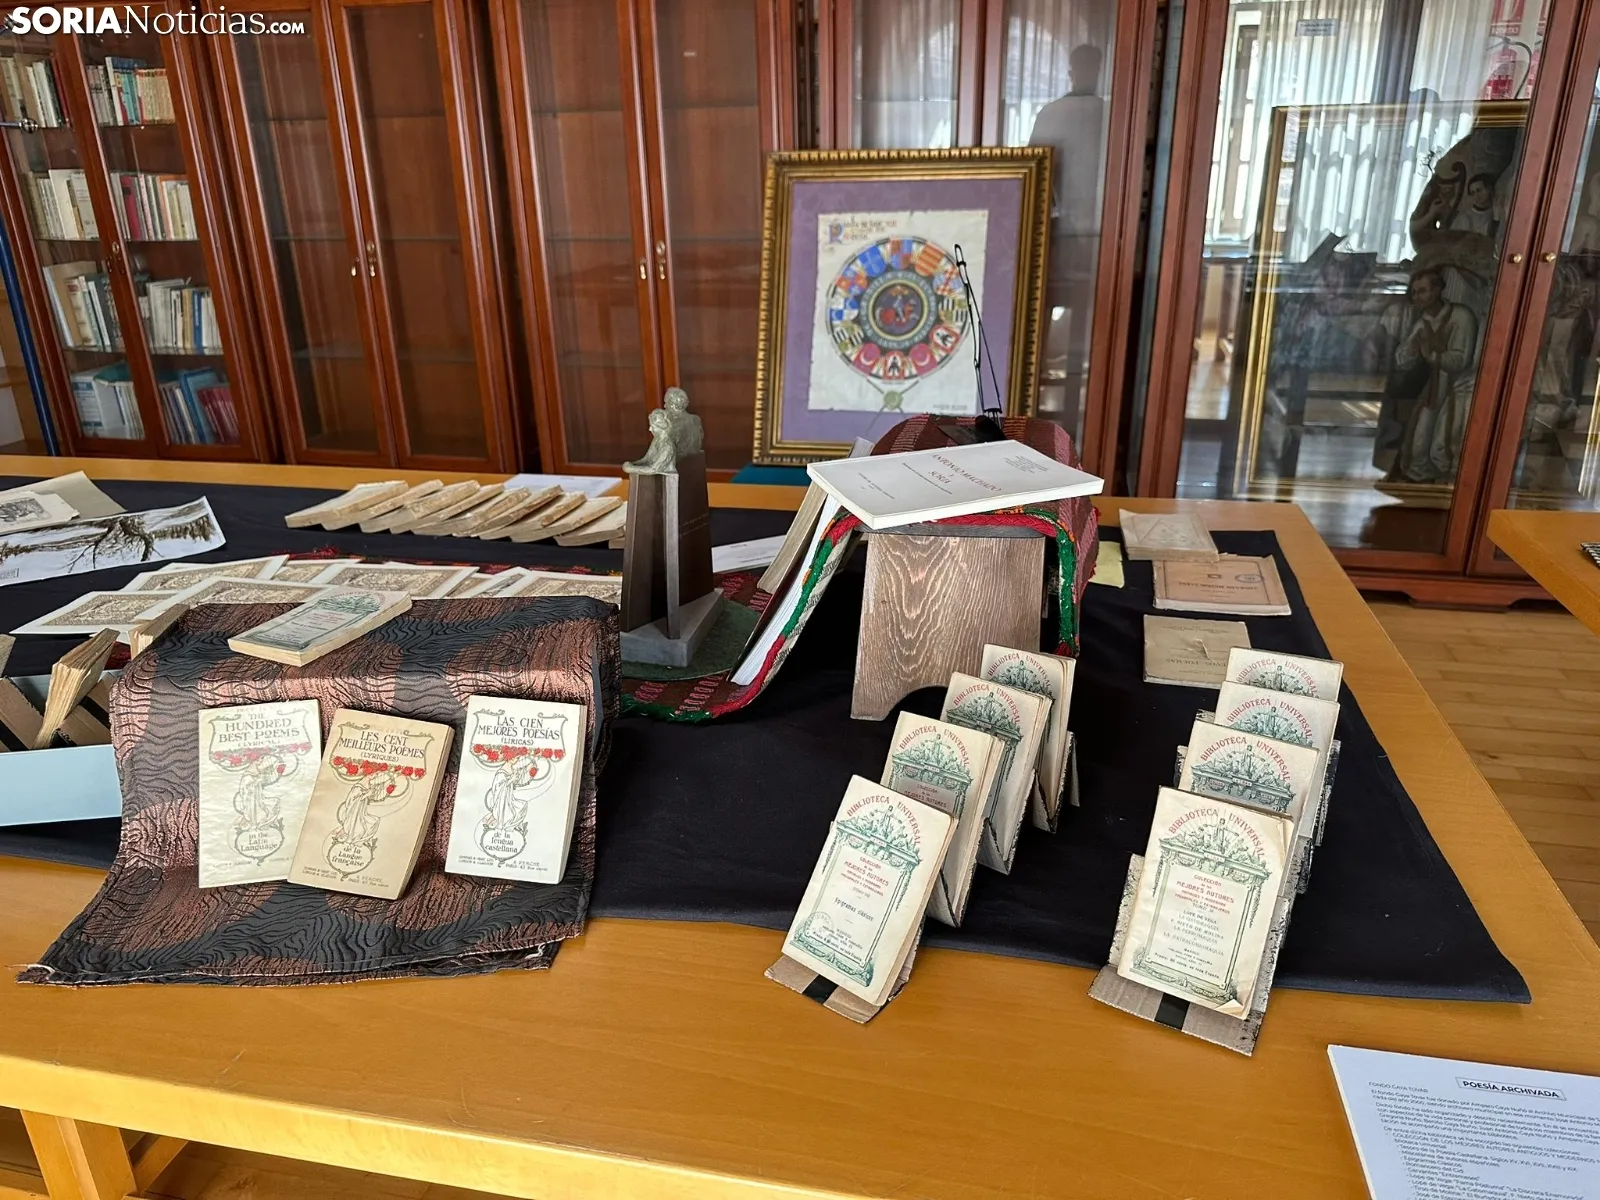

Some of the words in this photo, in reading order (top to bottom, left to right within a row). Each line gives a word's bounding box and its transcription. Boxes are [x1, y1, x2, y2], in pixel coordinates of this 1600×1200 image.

[987, 652, 1020, 676] BIBLIOTECA
[1025, 655, 1051, 688] UNIVERSAL
[1237, 658, 1276, 683] BIBLIOTECA
[1284, 660, 1318, 694] UNIVERSAL
[953, 683, 990, 706] BIBLIOTECA
[996, 687, 1021, 724] UNIVERSAL
[225, 718, 292, 732] HUNDRED
[497, 716, 515, 726] LAS
[519, 717, 543, 728] CIEN
[1227, 698, 1271, 723] BIBLIOTECA
[1279, 701, 1313, 739] UNIVERSAL
[219, 731, 251, 743] BEST
[255, 727, 300, 740] POEMS
[360, 731, 379, 741] LES
[383, 734, 409, 746] CENT
[478, 725, 518, 737] MEJORES
[523, 727, 560, 740] POESÍAS
[339, 737, 387, 753] MEILLEURS
[899, 725, 938, 750] BIBLIOTECA
[943, 729, 970, 767] UNIVERSAL
[360, 752, 399, 763] (LYRIQUES)
[1200, 736, 1247, 762] BIBLIOTECA
[1256, 740, 1291, 783] UNIVERSAL
[846, 795, 890, 817] BIBLIOTECA
[897, 801, 921, 844] UNIVERSAL
[1168, 808, 1219, 834] BIBLIOTECA
[1229, 813, 1265, 857] UNIVERSAL
[240, 843, 279, 852] Language
[343, 845, 352, 853] de
[353, 846, 361, 854] la
[484, 844, 518, 854] castellana
[490, 837, 514, 846] lengua
[331, 856, 365, 867] française
[337, 851, 363, 860] Langue
[1176, 880, 1205, 894] MEJORES
[1206, 890, 1235, 904] AUTORES
[1462, 1080, 1499, 1091] POESÍA
[1501, 1085, 1560, 1098] ARCHIVADA
